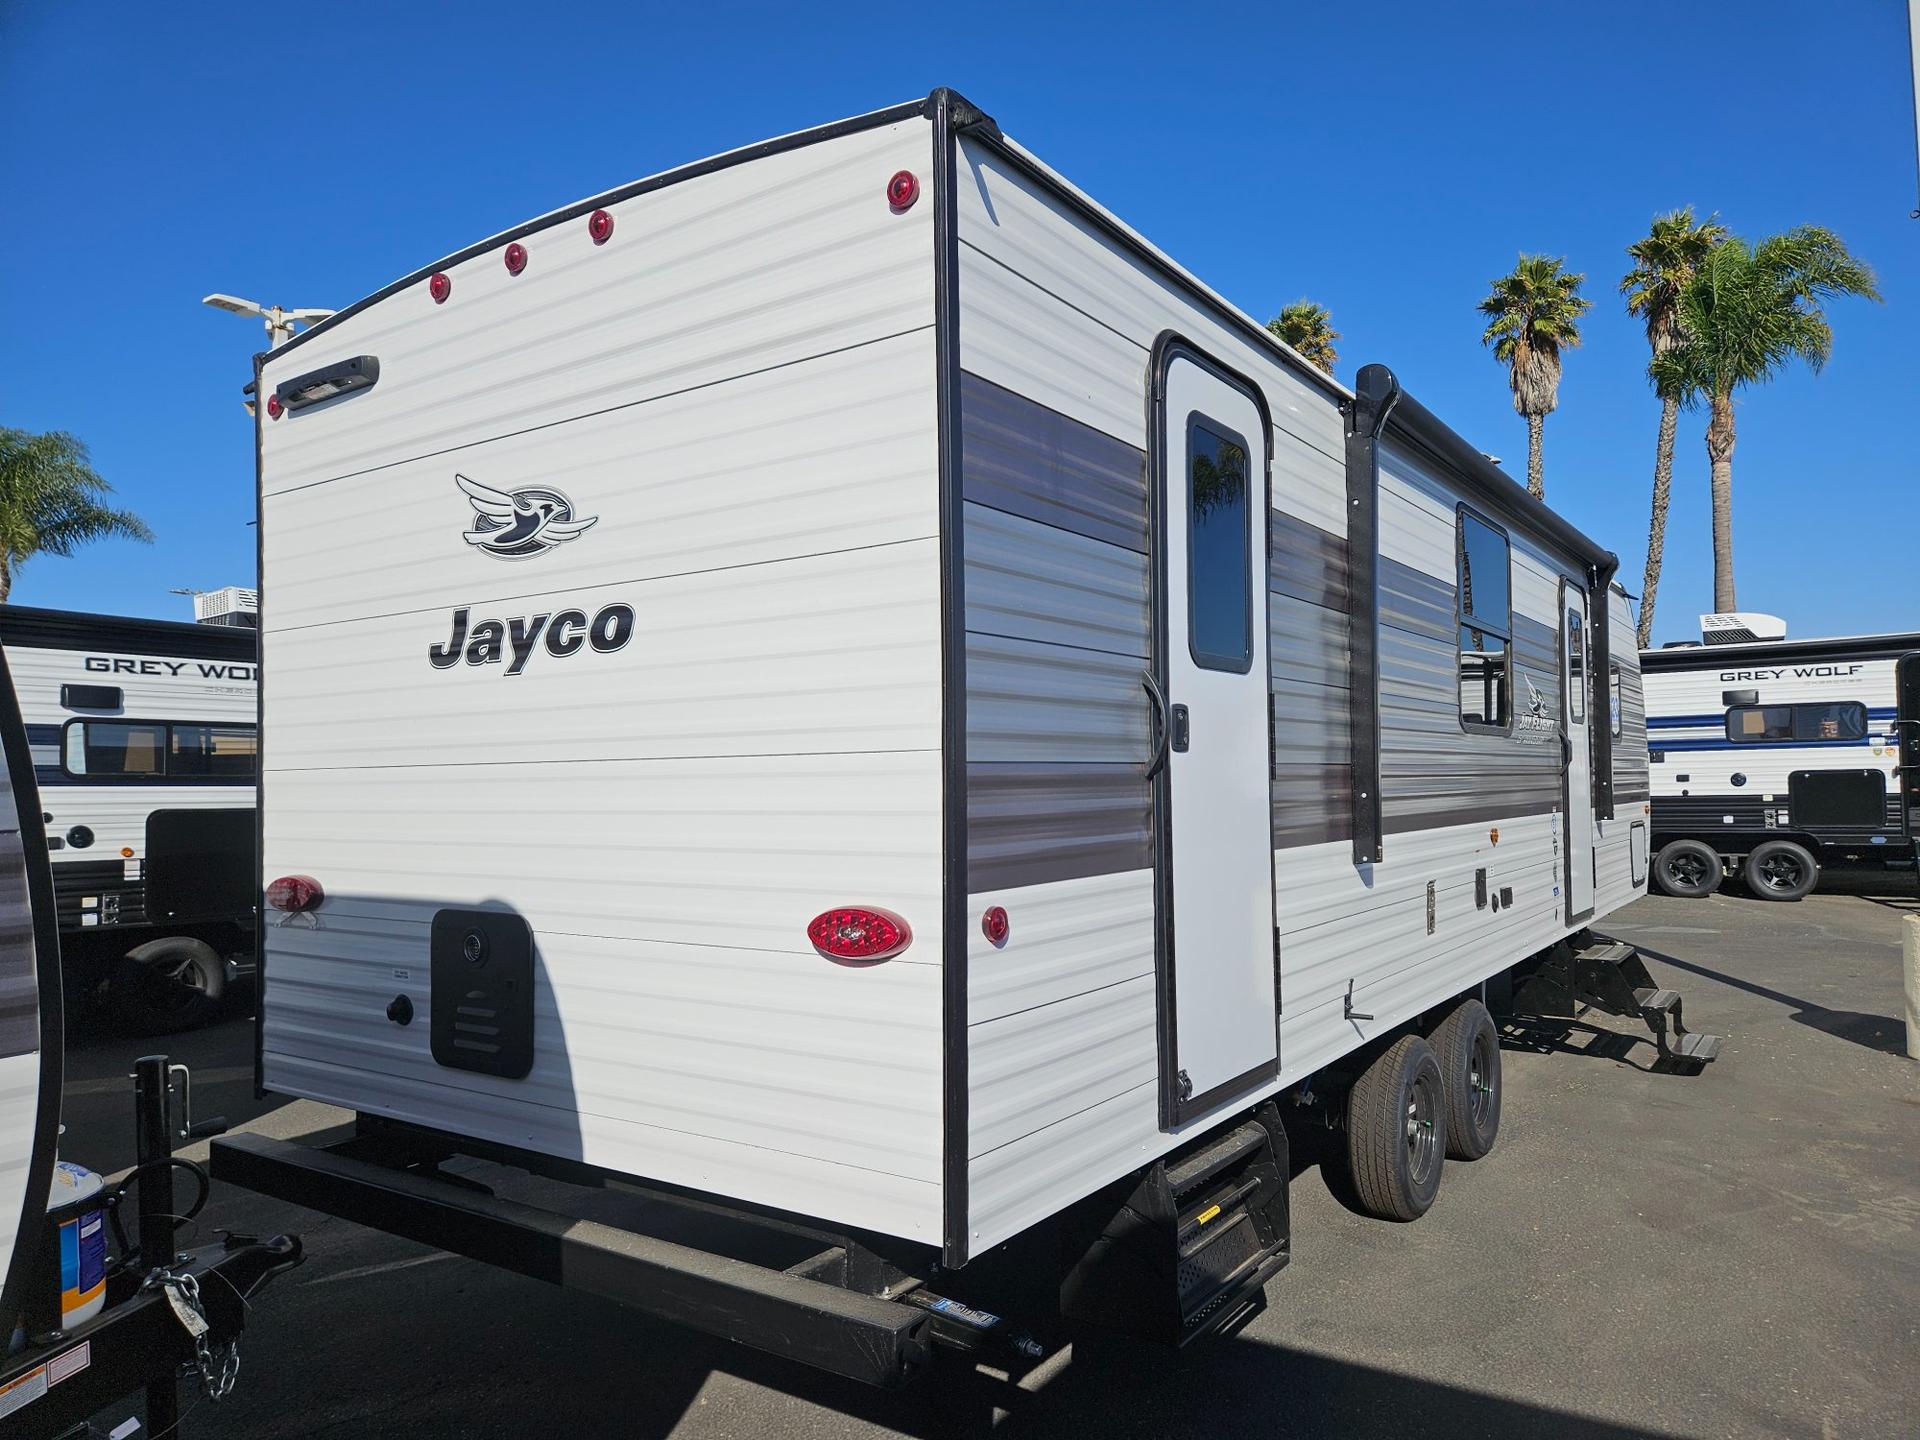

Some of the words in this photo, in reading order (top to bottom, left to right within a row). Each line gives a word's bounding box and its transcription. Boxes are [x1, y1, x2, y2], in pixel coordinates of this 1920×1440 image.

[428, 602, 637, 677] Jayco
[85, 656, 188, 677] GREY
[1720, 669, 1785, 682] GREY
[1793, 665, 1864, 678] WOLF
